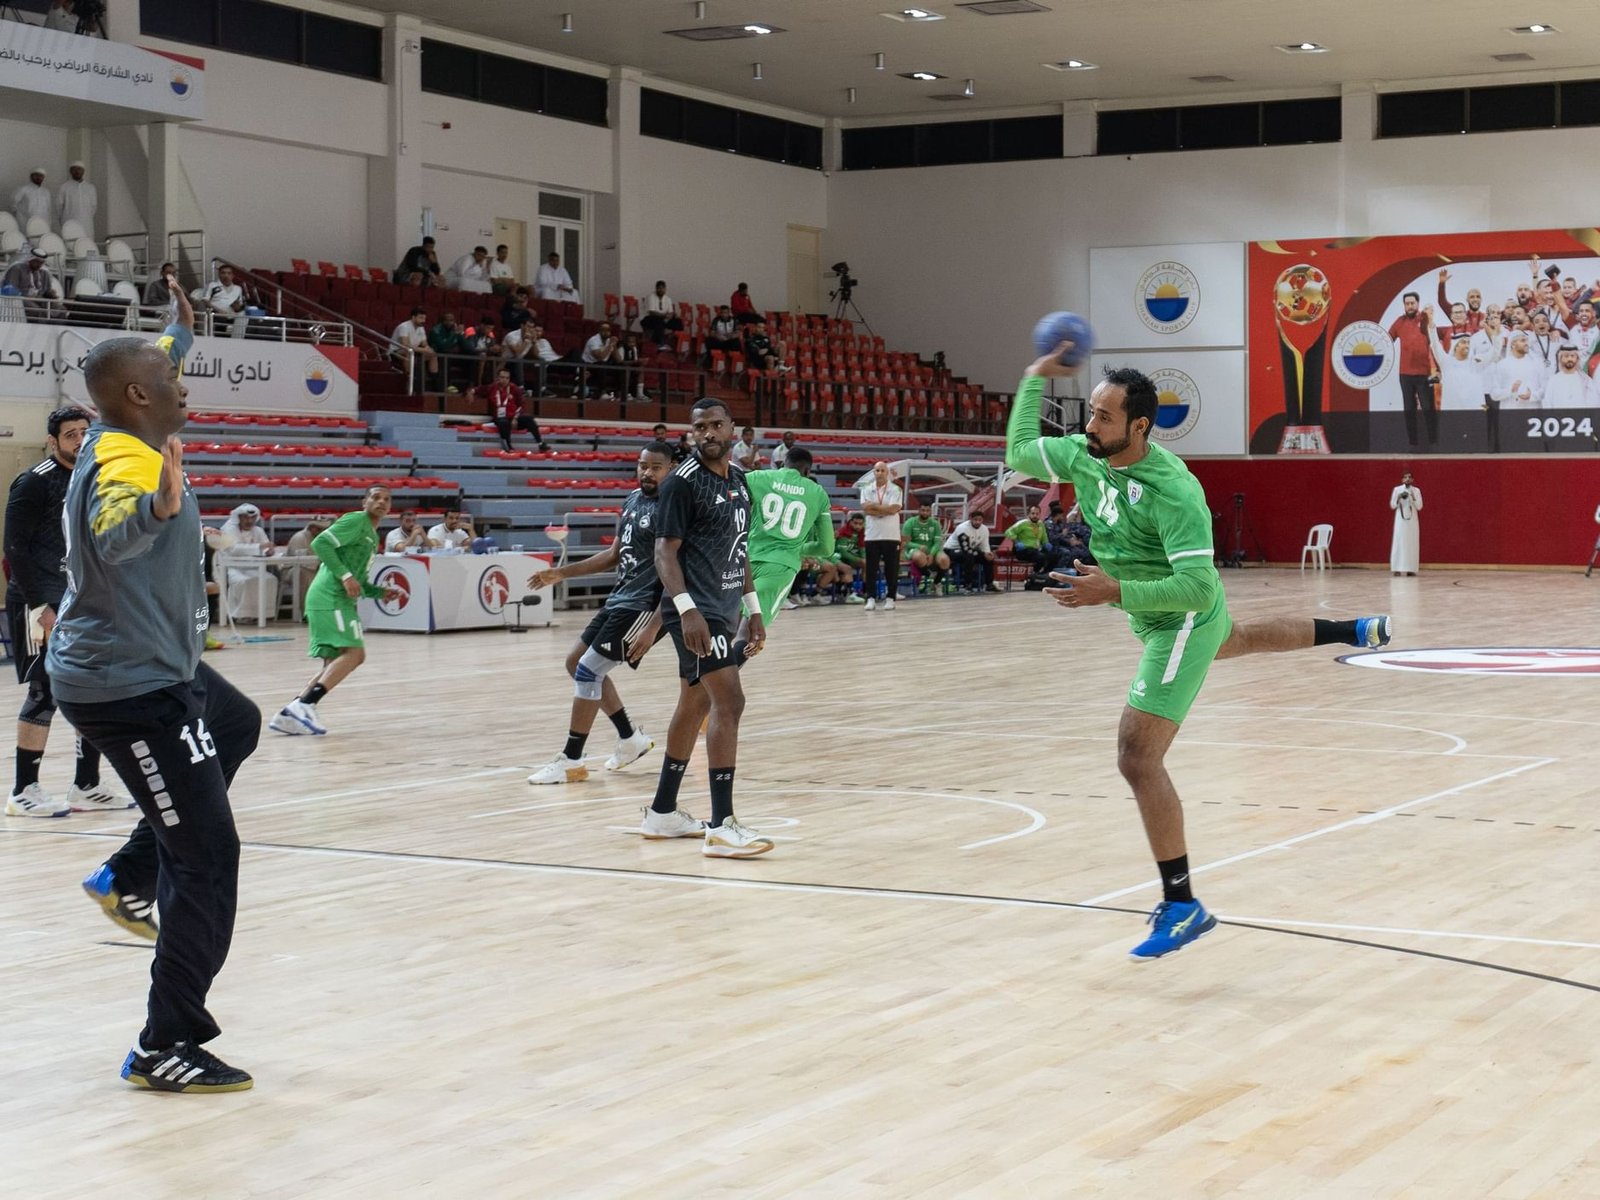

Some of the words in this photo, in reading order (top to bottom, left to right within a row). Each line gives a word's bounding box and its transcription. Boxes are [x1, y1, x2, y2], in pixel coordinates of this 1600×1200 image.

[22, 54, 52, 68] يرحب
[53, 59, 92, 74] الرياضي
[93, 63, 131, 79] الشارقة
[132, 73, 153, 86] نادي
[227, 360, 271, 391] نادي
[1527, 417, 1593, 437] 2024
[772, 481, 805, 496] MANDO
[1096, 480, 1119, 527] 14
[734, 508, 746, 532] 19
[762, 492, 807, 539] 90
[710, 634, 728, 659] 19
[715, 773, 731, 781] 23
